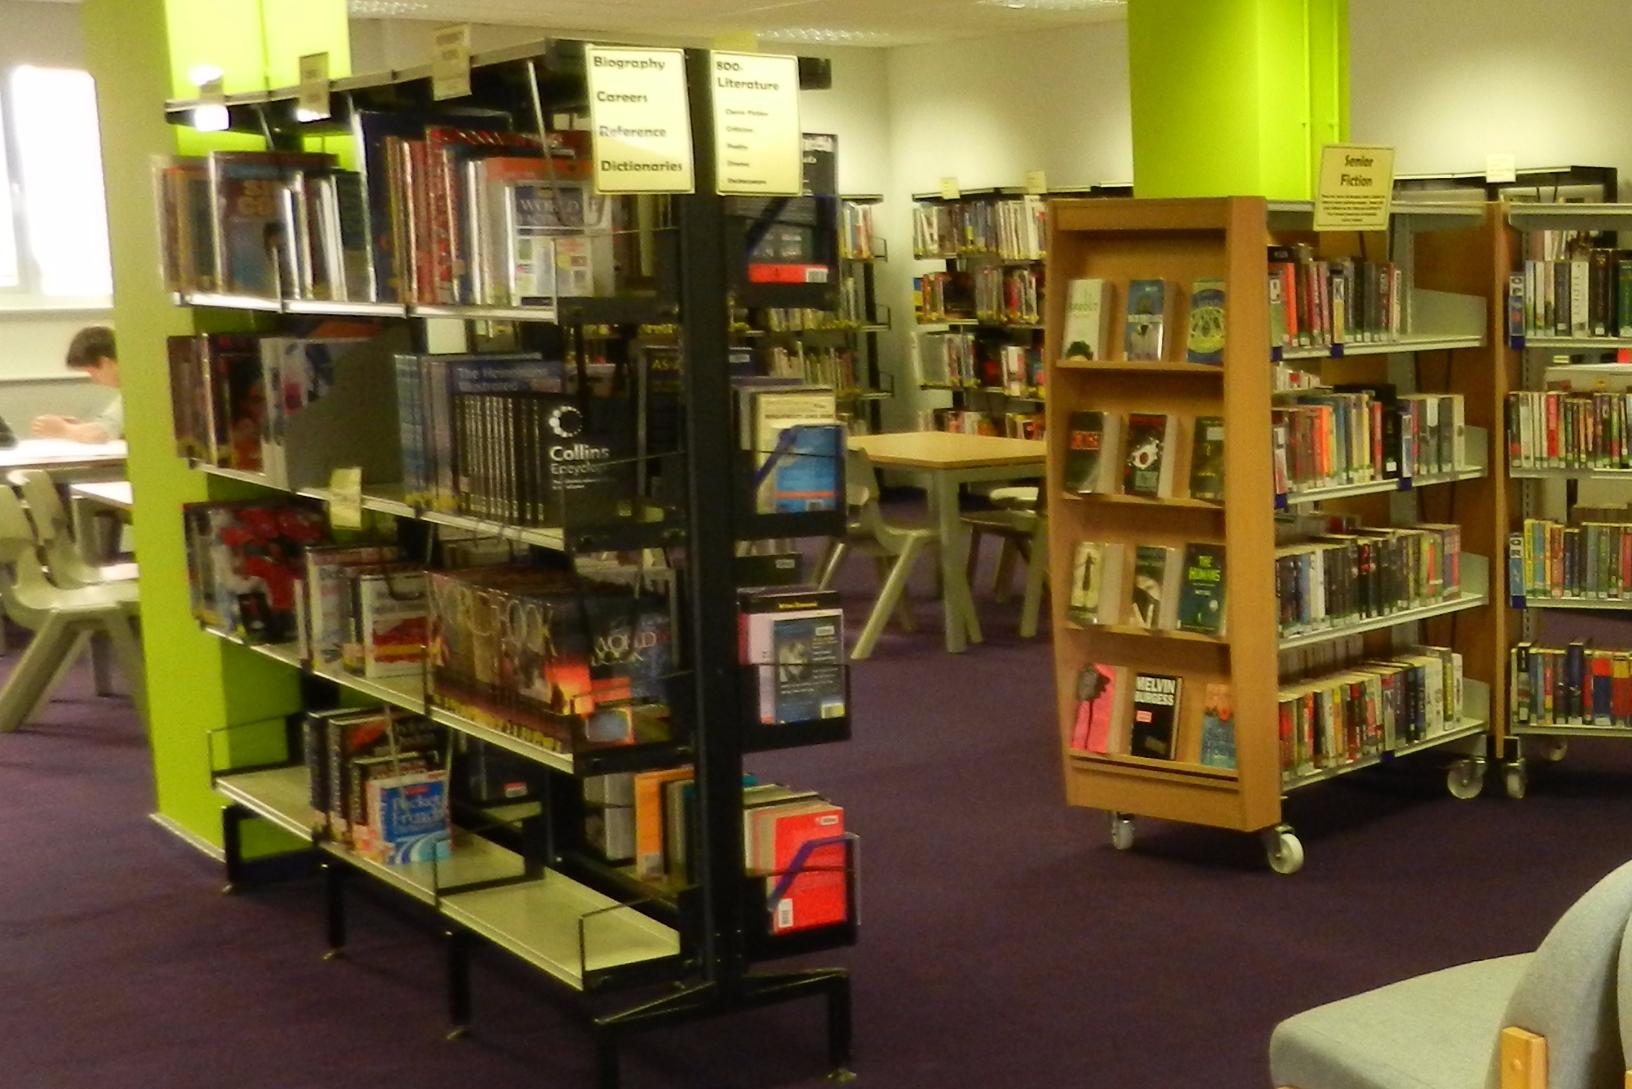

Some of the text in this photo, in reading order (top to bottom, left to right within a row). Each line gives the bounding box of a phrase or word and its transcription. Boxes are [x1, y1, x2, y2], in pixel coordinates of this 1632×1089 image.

[593, 56, 666, 71] Biography
[717, 77, 780, 91] Literature
[596, 91, 648, 103] Careers
[599, 125, 667, 138] Reference
[601, 160, 682, 172] Dictionaries
[1345, 154, 1374, 168] Senior
[1340, 173, 1373, 187] Fiction
[550, 444, 610, 462] Collins
[1135, 676, 1176, 694] MELVIN
[1134, 691, 1174, 707] BURGESS
